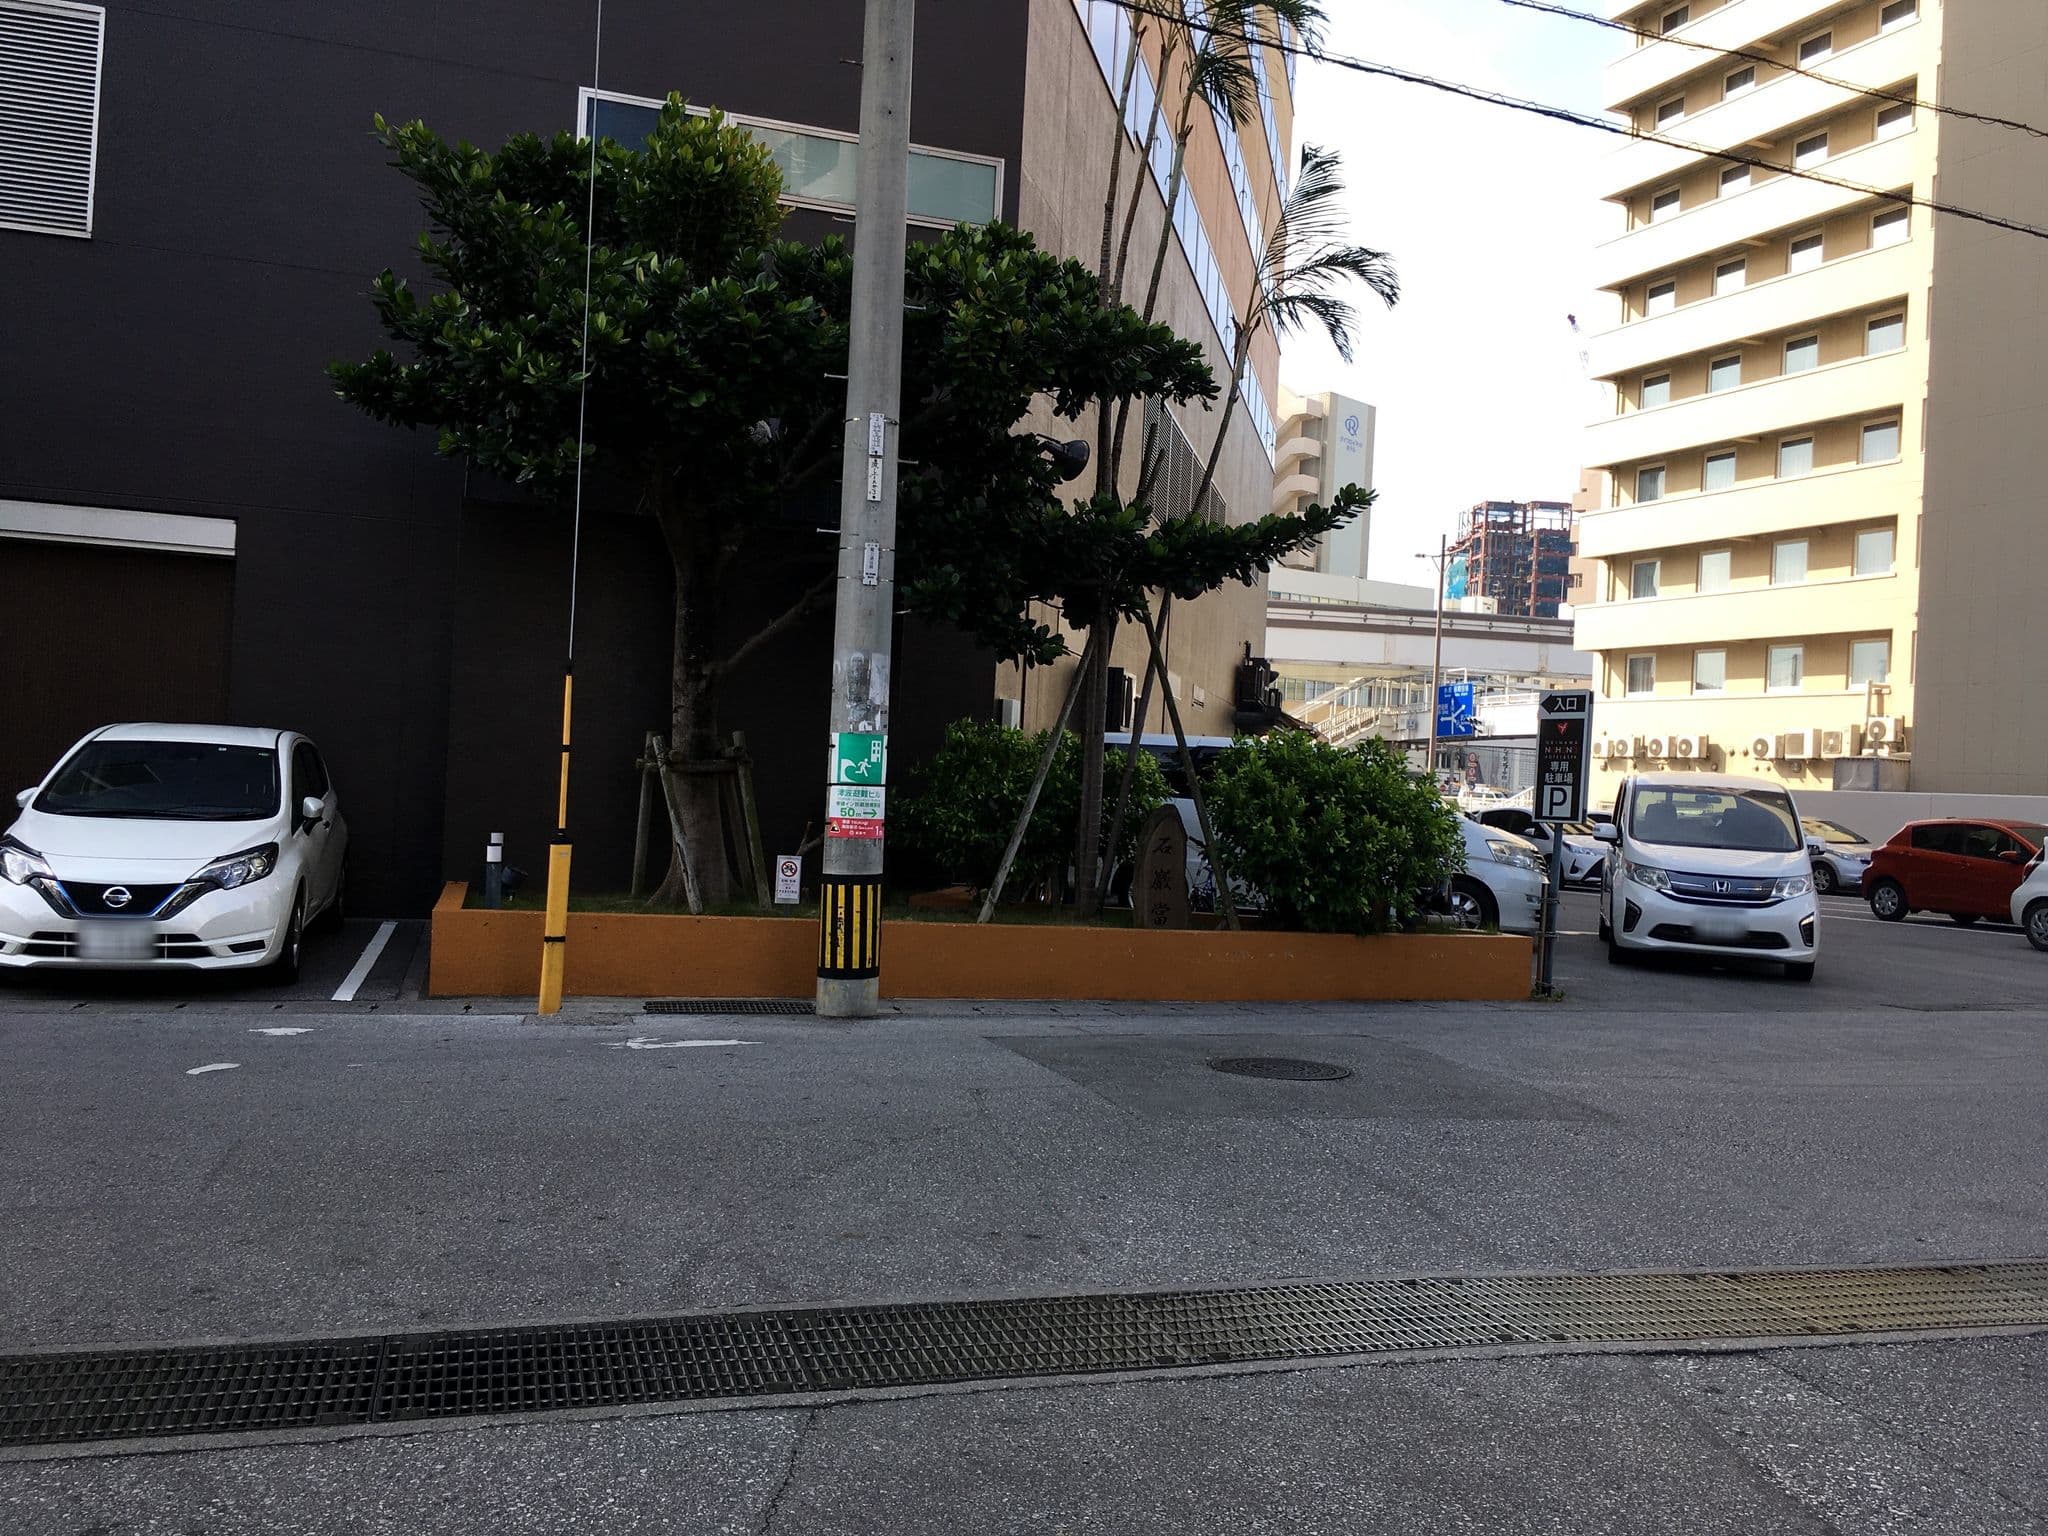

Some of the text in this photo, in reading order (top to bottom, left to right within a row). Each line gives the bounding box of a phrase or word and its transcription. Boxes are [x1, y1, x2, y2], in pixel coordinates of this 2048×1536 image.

[1553, 697, 1577, 711] 入口
[1550, 761, 1569, 773] 専用
[1544, 773, 1573, 785] 駐車場
[838, 789, 880, 798] 津波避難ビル
[1549, 787, 1568, 816] P
